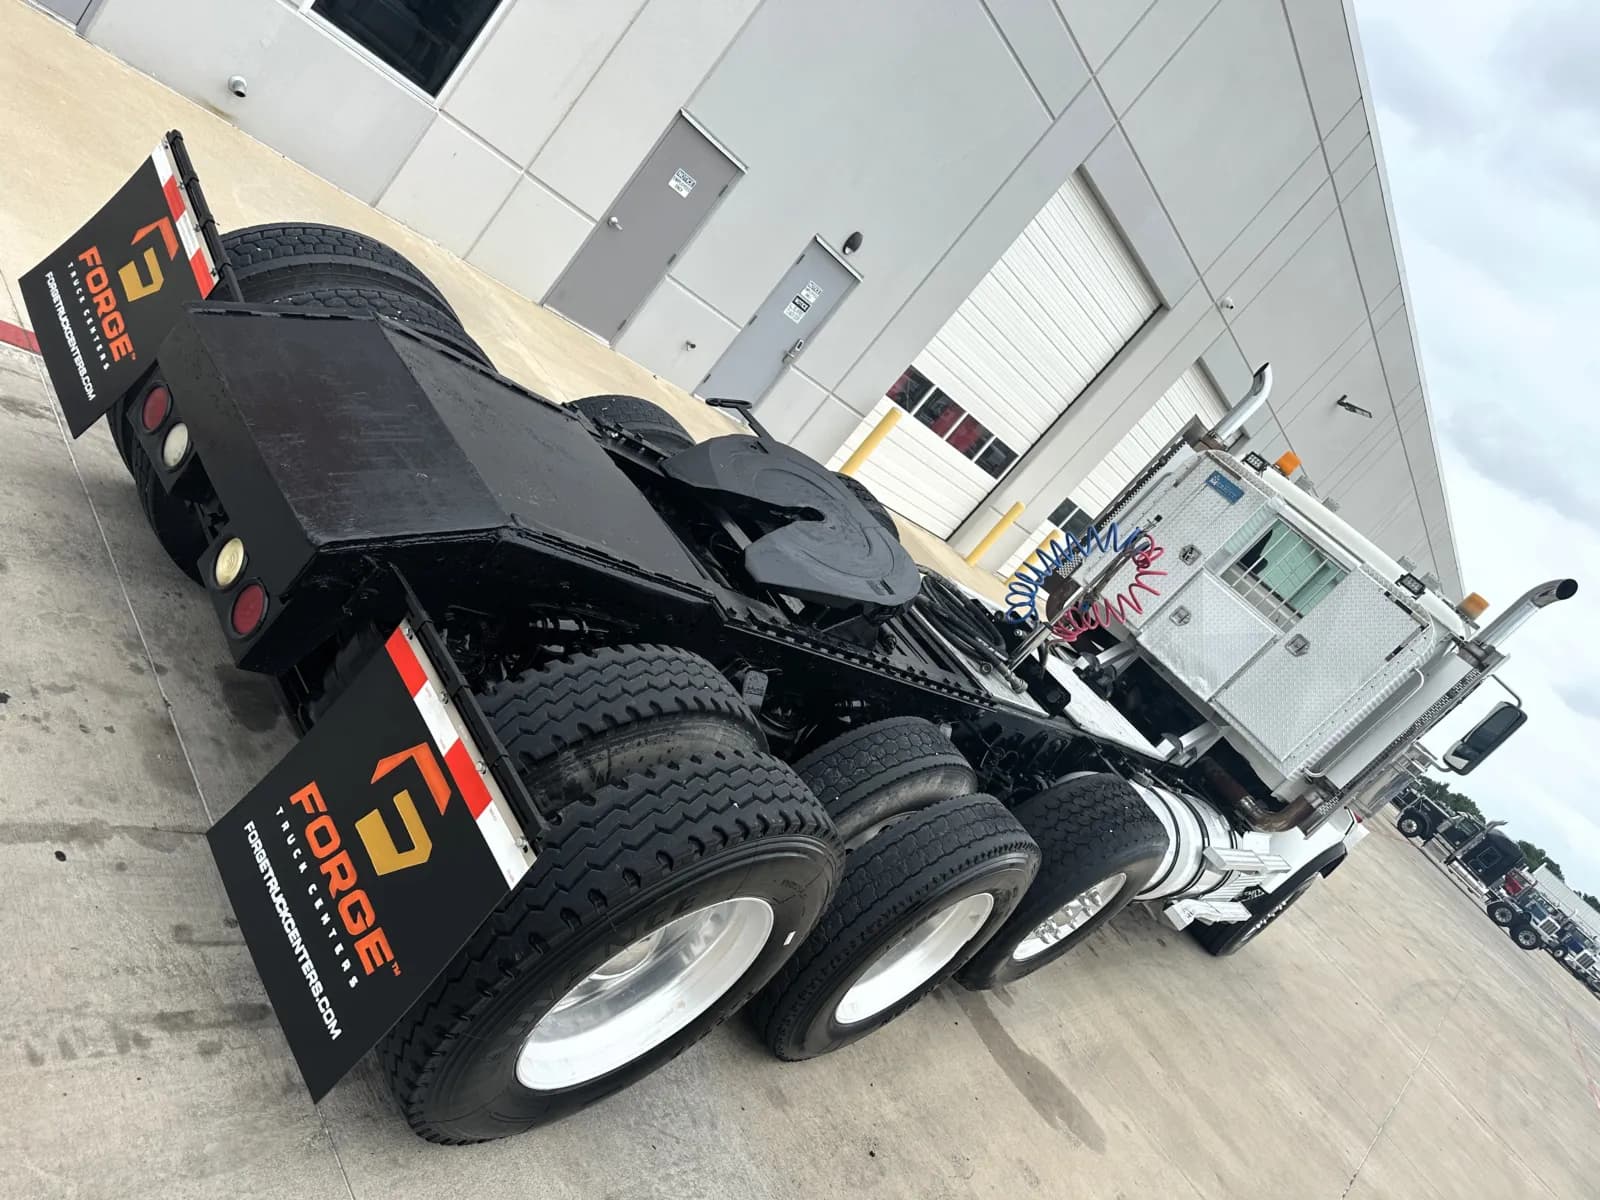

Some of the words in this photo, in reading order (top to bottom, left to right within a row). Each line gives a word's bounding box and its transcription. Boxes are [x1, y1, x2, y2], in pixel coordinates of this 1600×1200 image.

[44, 271, 97, 401] FORGETRUCKCENTERS.COM
[67, 261, 86, 304] TRUCK
[83, 308, 110, 371] CENTERS
[243, 820, 342, 1041] FORGETRUCKCENTERS.COM
[275, 805, 308, 874] TRUCK
[308, 883, 359, 989] CENTERS
